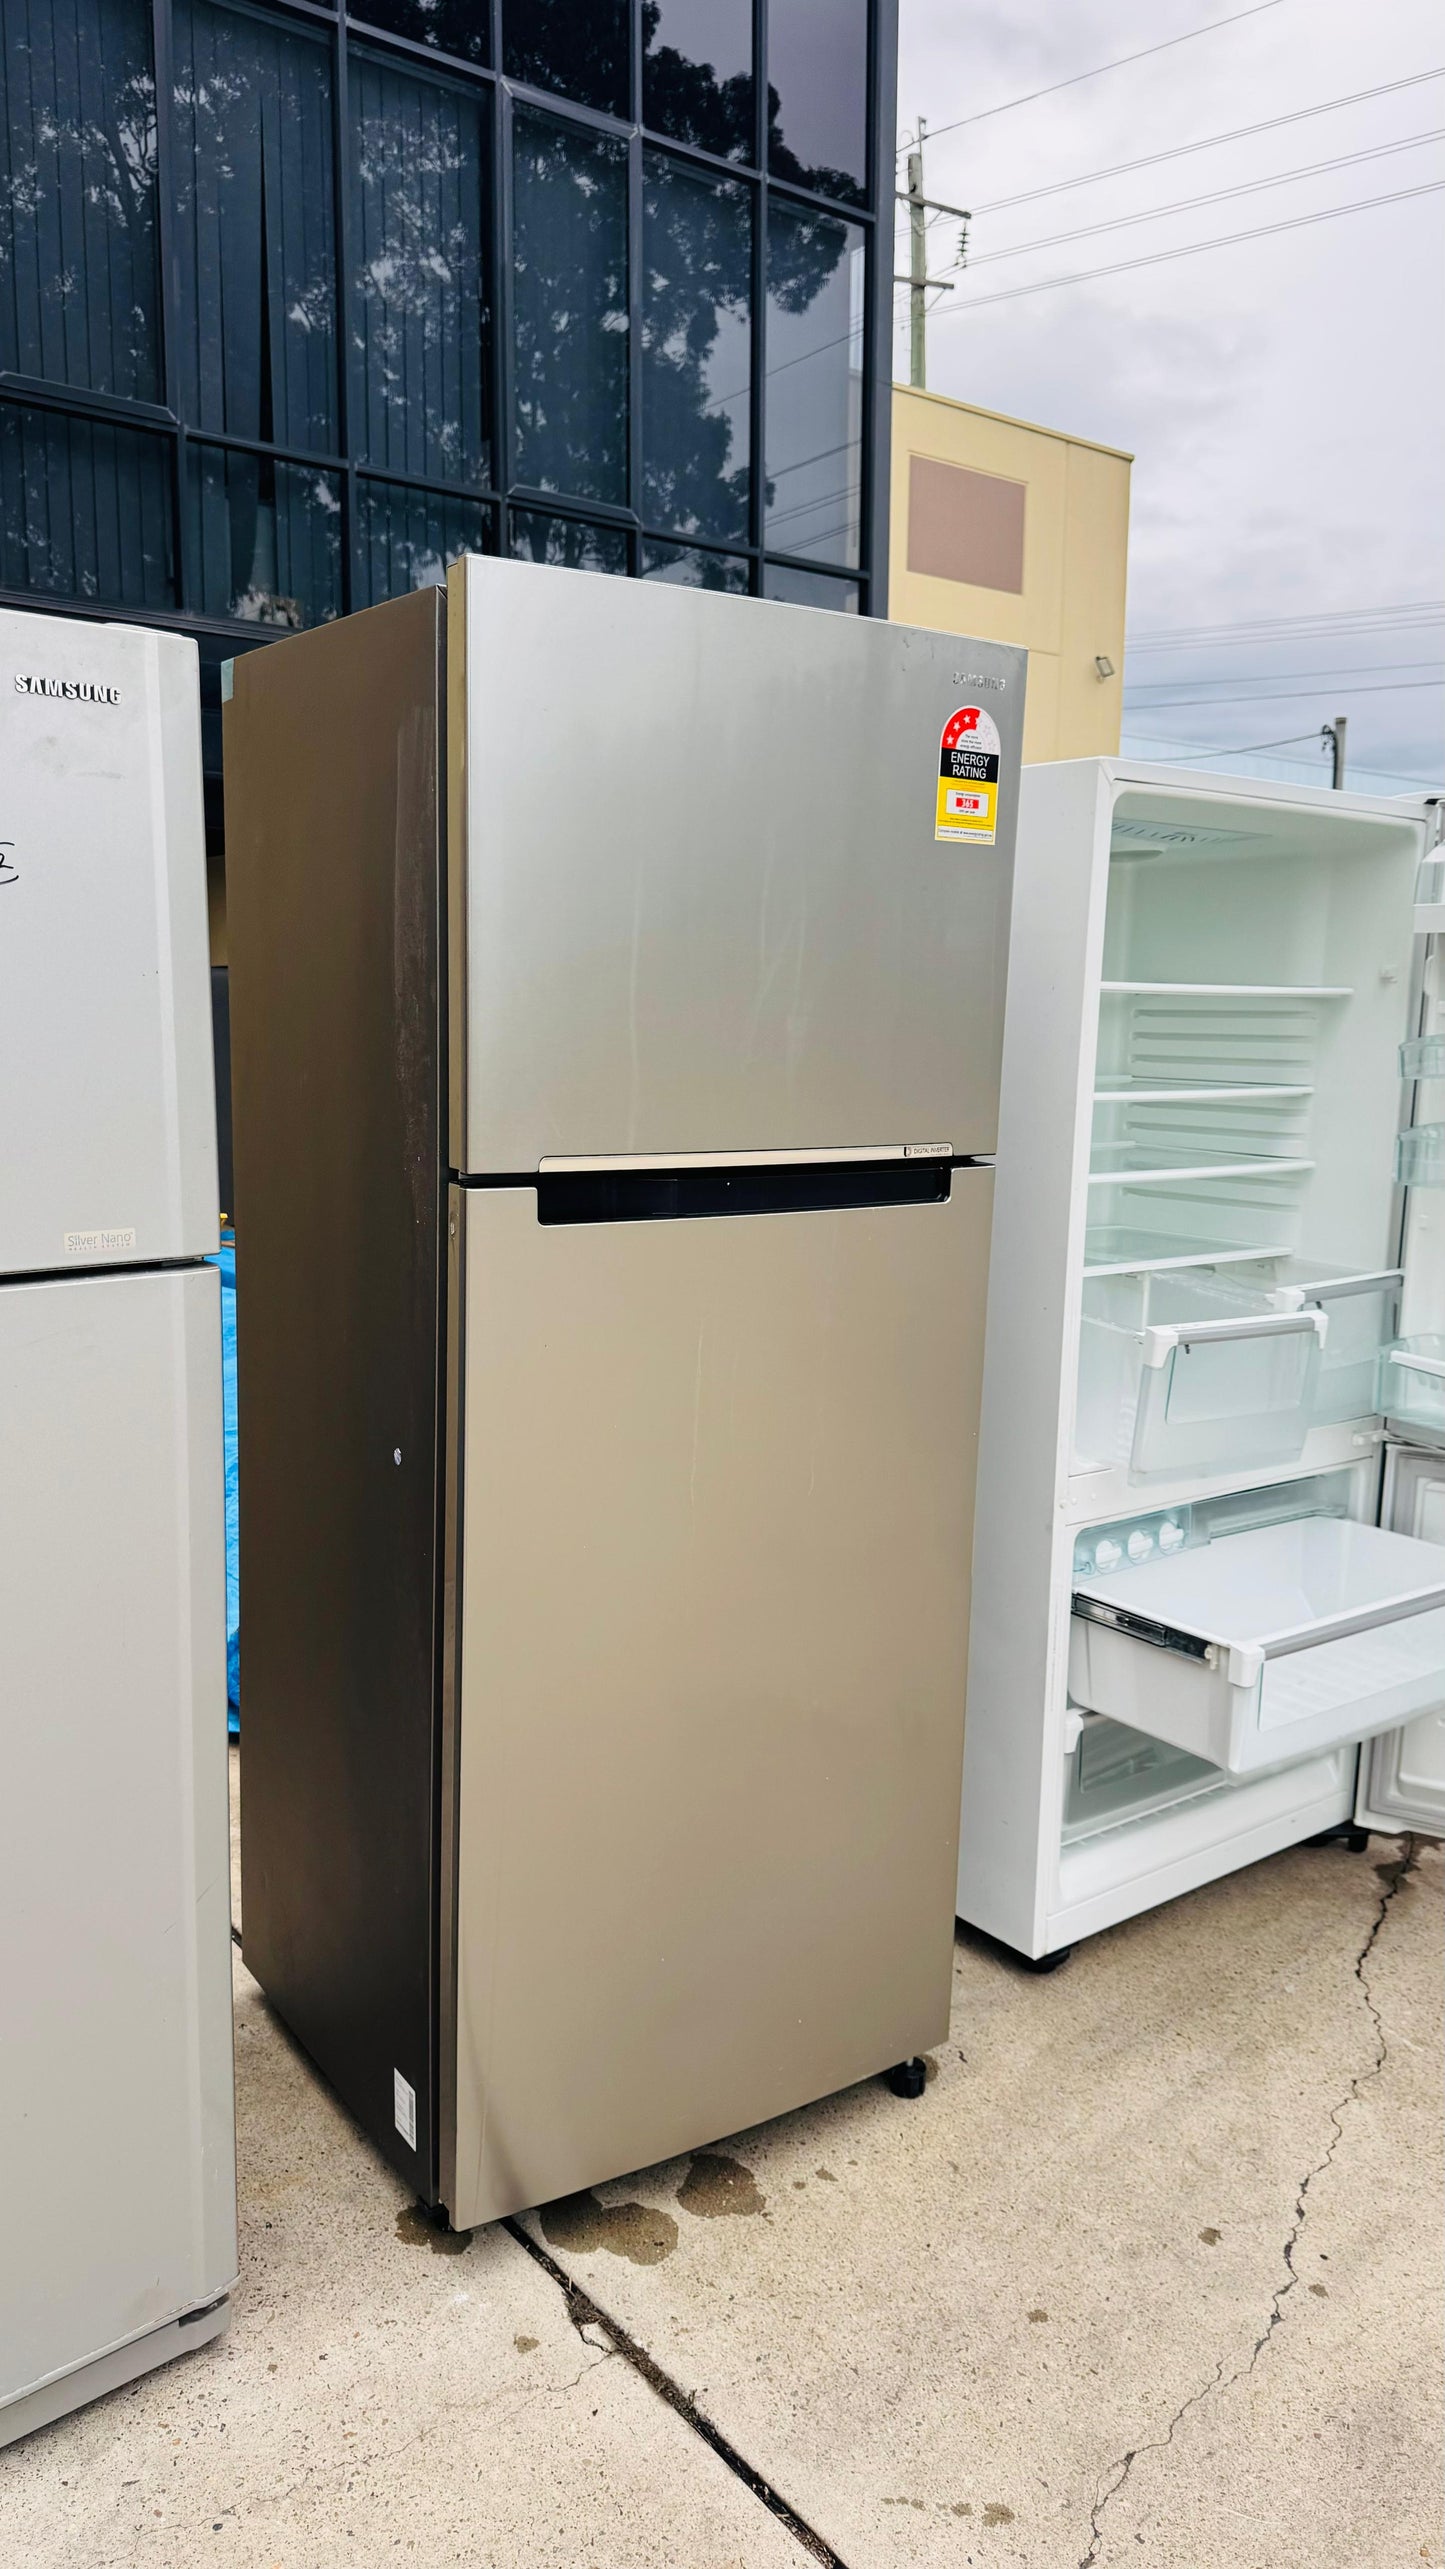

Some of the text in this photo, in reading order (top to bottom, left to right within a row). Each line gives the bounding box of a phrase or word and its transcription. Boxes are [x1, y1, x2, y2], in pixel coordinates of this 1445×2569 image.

[15, 673, 122, 705] SAMSUNG
[952, 671, 1006, 691] SAMSUNG
[951, 751, 990, 767] ENERGY
[952, 764, 987, 779] RATING
[68, 1234, 98, 1247] Silver
